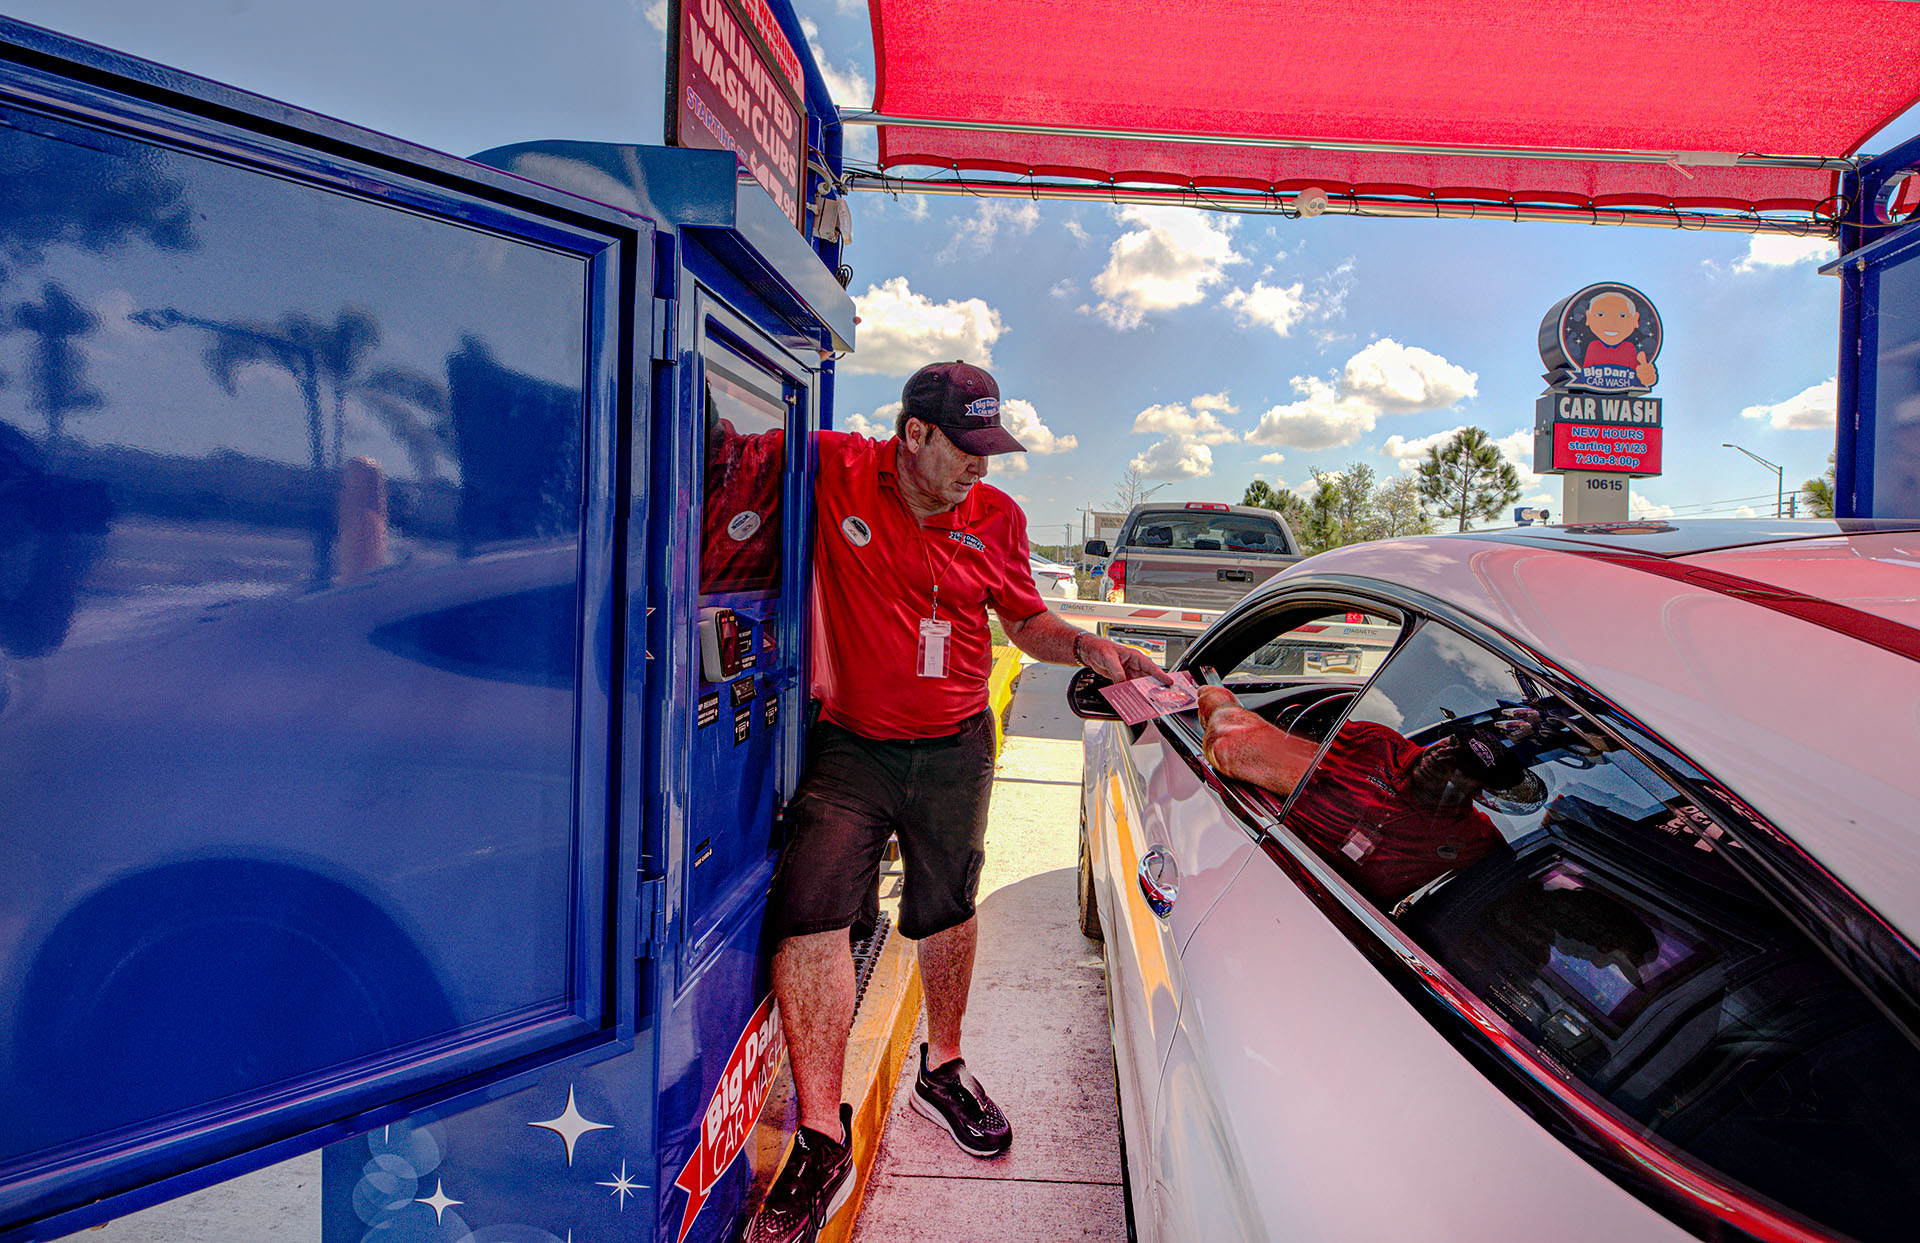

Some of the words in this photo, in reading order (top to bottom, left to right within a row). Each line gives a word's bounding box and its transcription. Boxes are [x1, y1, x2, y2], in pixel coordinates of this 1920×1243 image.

[701, 0, 793, 140] UNLIMITED
[688, 11, 750, 130] WASH
[752, 105, 797, 189] CLUBS
[686, 86, 736, 152] STARTING
[1583, 366, 1603, 378] Big
[1603, 367, 1635, 379] Dan's
[1586, 376, 1604, 386] CAR
[1605, 378, 1631, 387] WASH
[1559, 396, 1597, 421] CAR
[1602, 399, 1658, 424] WASH
[1571, 426, 1599, 438] NEW
[1602, 428, 1644, 440] HOURS
[1568, 441, 1611, 454] starting
[1614, 442, 1647, 454] 3/1/23
[1575, 454, 1640, 468] 7:30a-8:00p
[1585, 479, 1623, 491] 10615
[707, 1059, 743, 1150] Big
[713, 1103, 745, 1176] CAR
[748, 1031, 783, 1120] WASH
